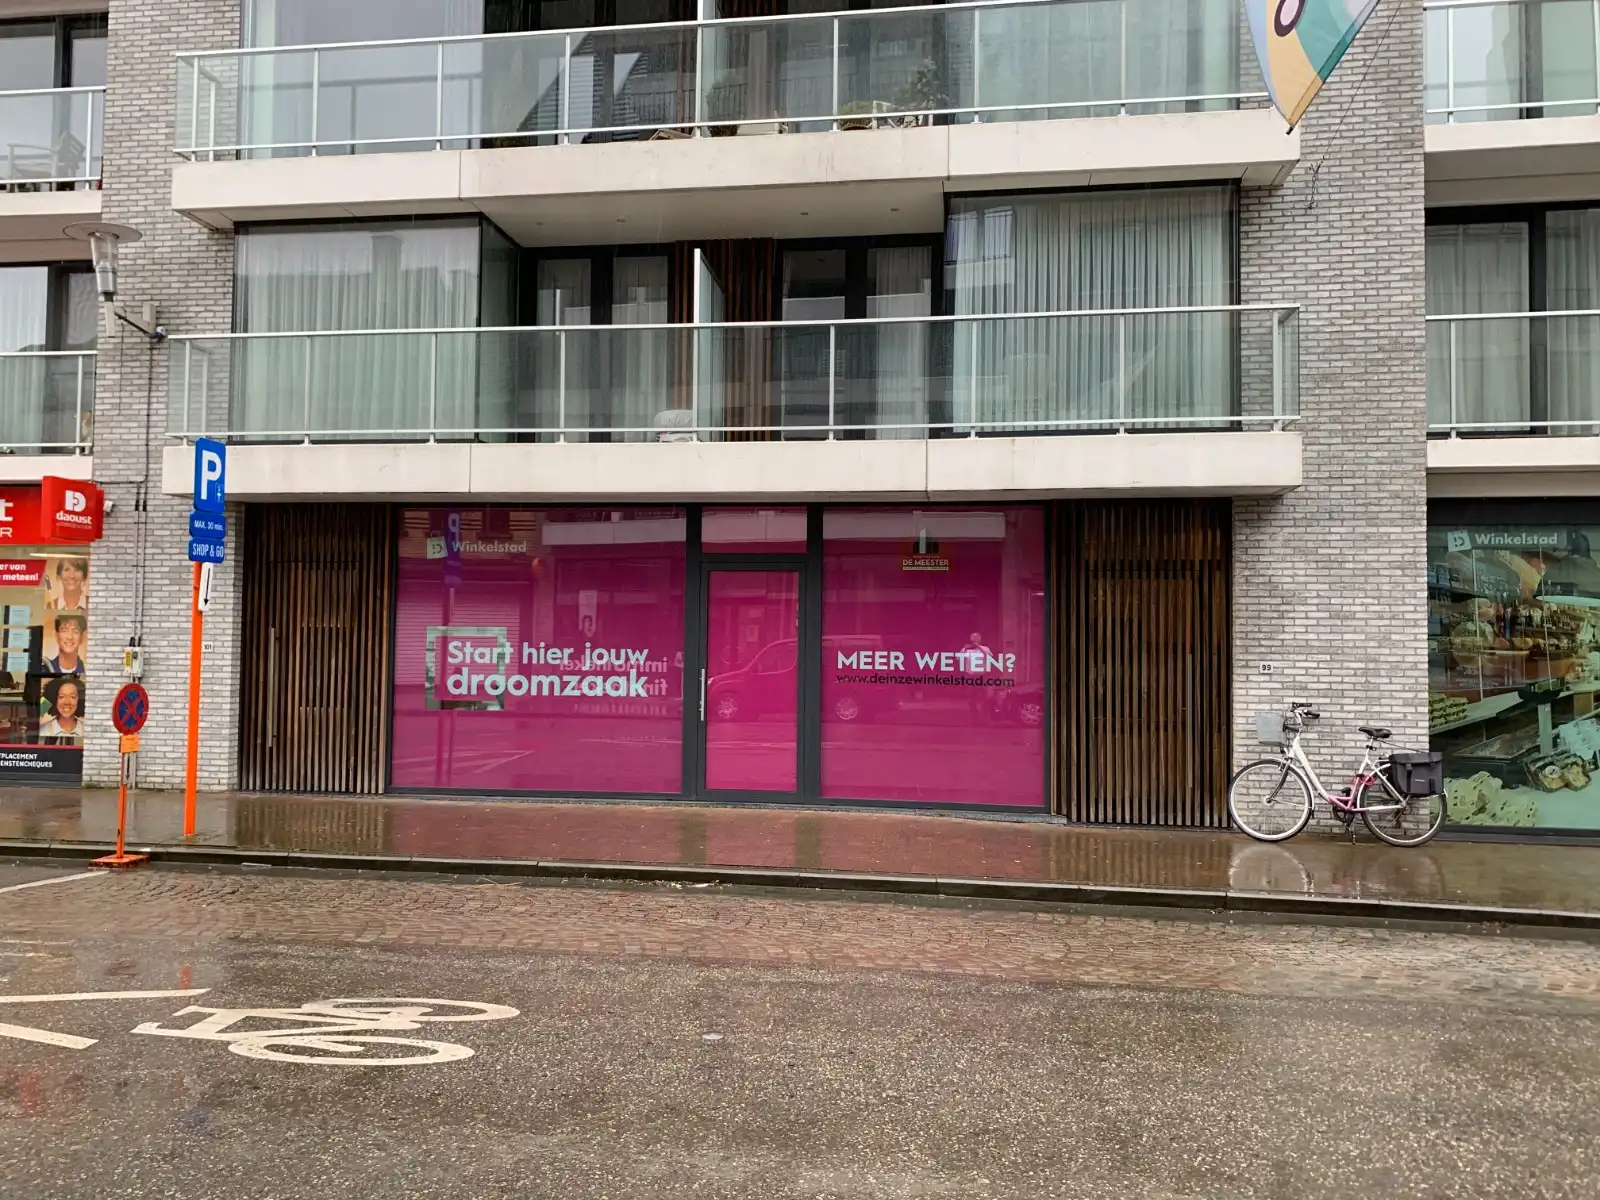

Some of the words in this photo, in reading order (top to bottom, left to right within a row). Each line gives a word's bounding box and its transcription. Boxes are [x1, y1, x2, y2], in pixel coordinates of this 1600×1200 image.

[201, 449, 222, 500] P
[56, 510, 93, 525] daoust
[194, 520, 207, 530] MAX.
[207, 521, 214, 530] 30
[214, 523, 224, 531] min.
[1475, 532, 1558, 545] Winkelstad
[192, 543, 209, 557] SHOP
[209, 545, 215, 557] &
[215, 545, 224, 558] GO
[452, 540, 527, 553] Winkelstad
[2, 572, 39, 581] meteen!
[448, 641, 513, 665] Start
[522, 642, 574, 665] hier
[582, 642, 649, 671] jouw
[837, 650, 905, 671] MEER
[915, 651, 1016, 673] WETEN?
[447, 667, 649, 698] droomzaak
[837, 673, 1015, 688] www.deinzewinkelstad.com
